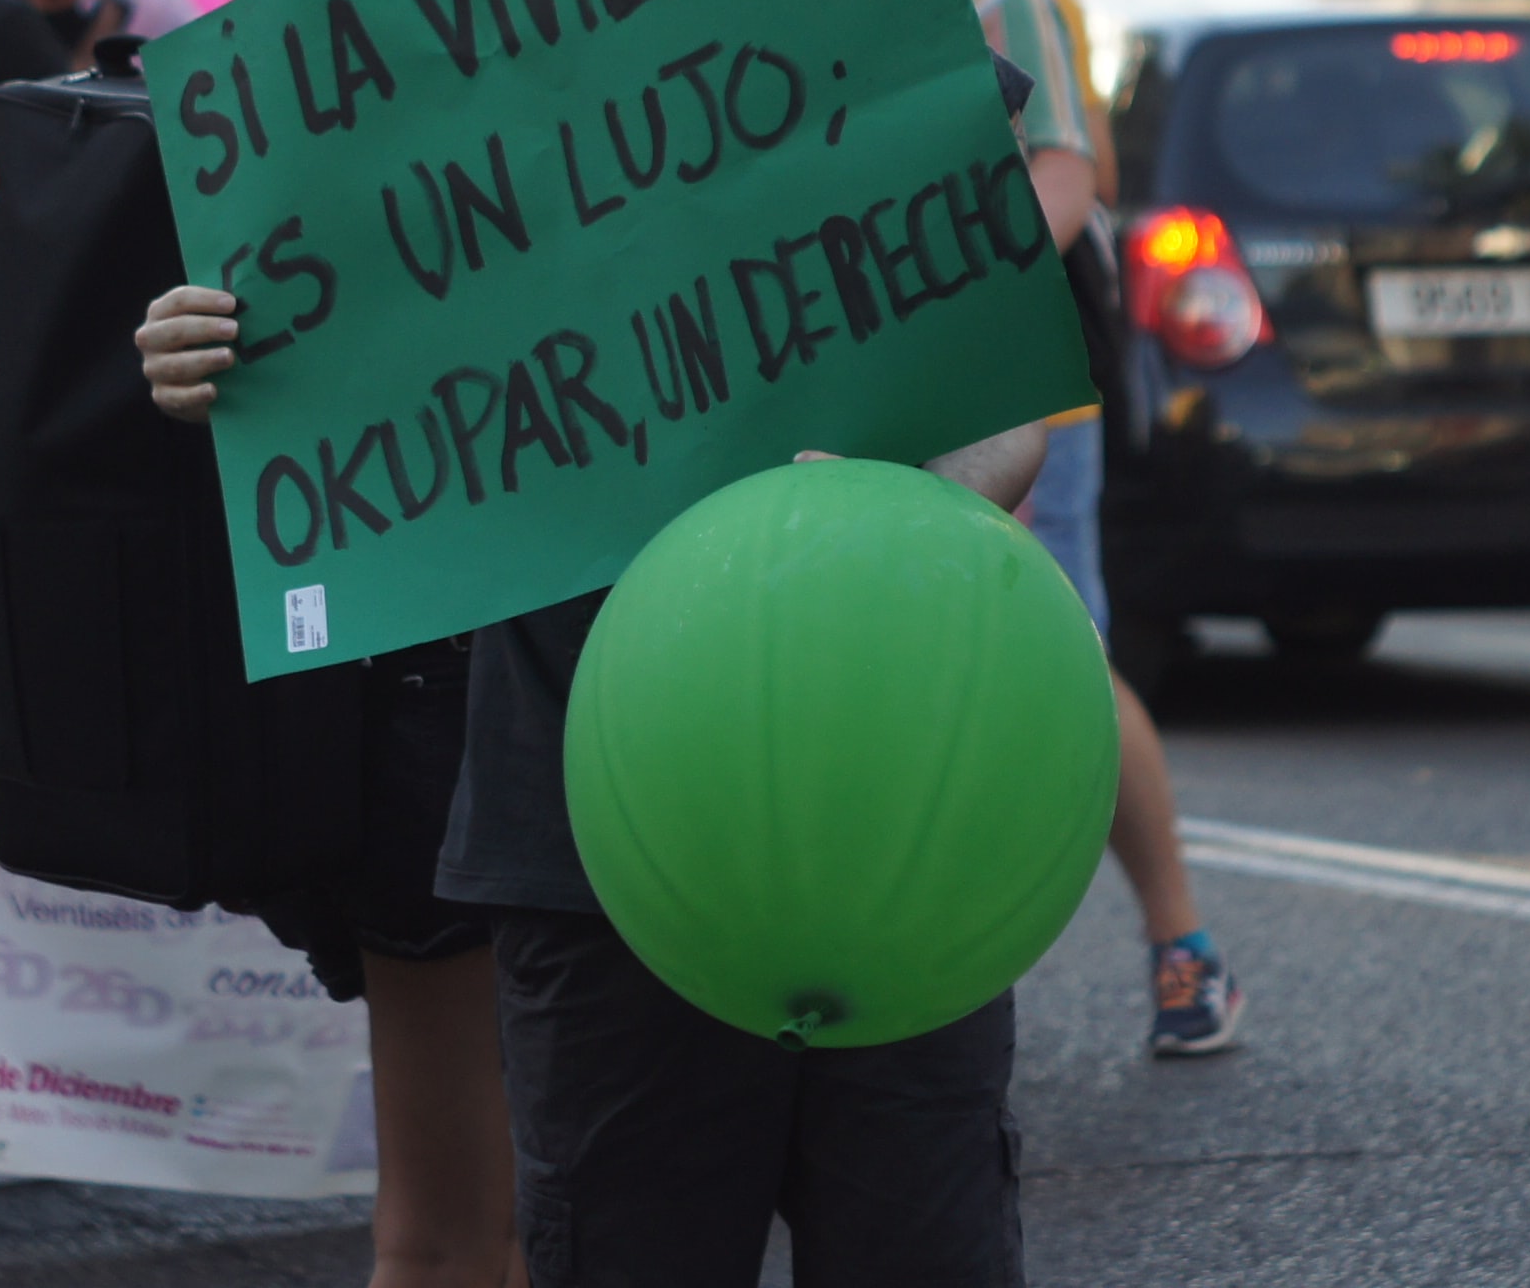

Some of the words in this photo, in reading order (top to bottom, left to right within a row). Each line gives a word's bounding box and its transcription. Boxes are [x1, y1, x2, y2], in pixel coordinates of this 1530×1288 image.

[219, 214, 336, 366] ES
[381, 133, 532, 301] UN
[558, 39, 849, 229] LUJO;
[255, 328, 649, 567] OKUPAR,
[630, 275, 730, 421] UN
[730, 151, 1047, 385] DERECHO
[27, 1061, 181, 1117] Diciembre
